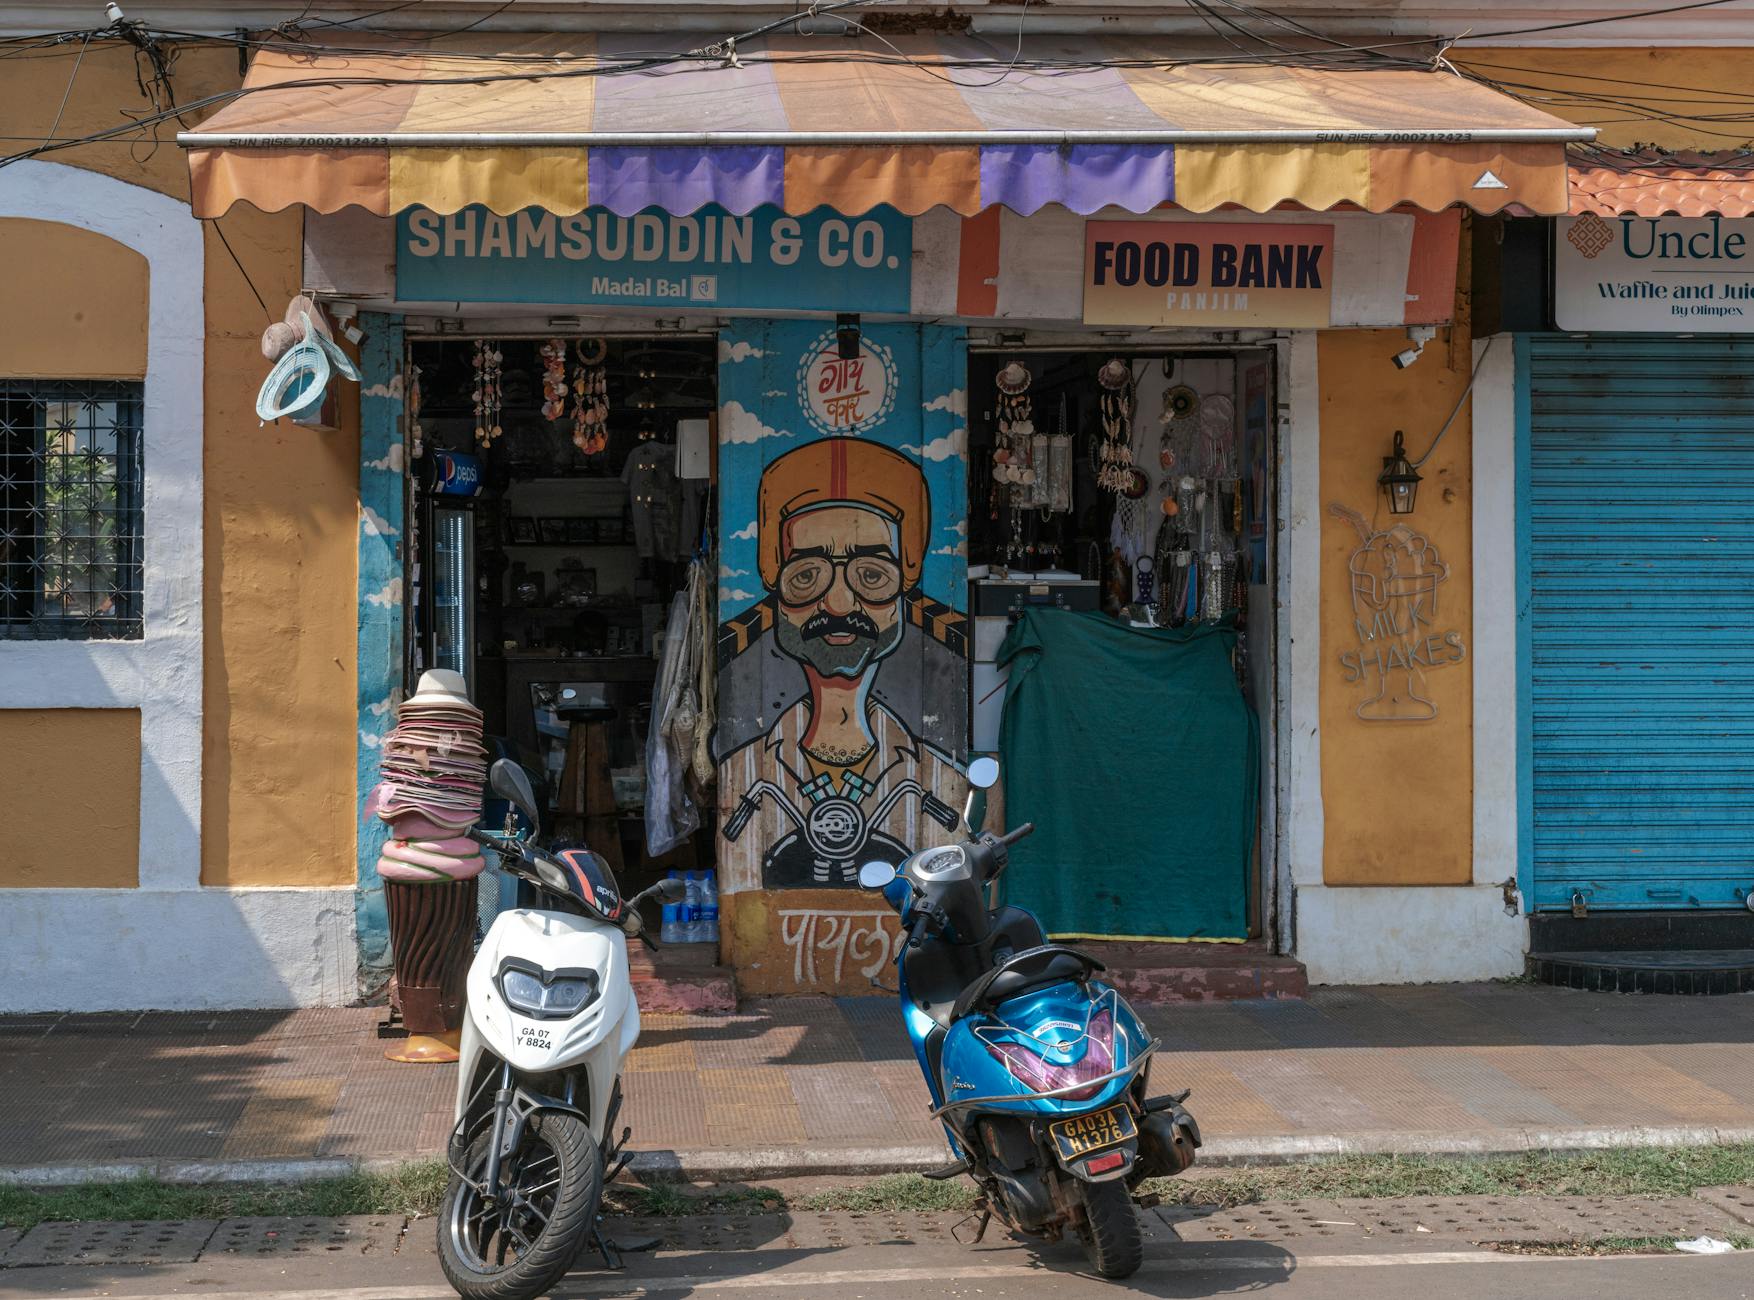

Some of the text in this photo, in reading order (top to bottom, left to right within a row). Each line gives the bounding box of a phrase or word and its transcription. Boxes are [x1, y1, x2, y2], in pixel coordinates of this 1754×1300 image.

[228, 137, 389, 147] SUN RISE 7000212423
[1315, 133, 1472, 142] SUN RISE 7000212423
[408, 209, 899, 269] SHAMSUDDIN & CO.
[1619, 216, 1746, 259] Uncle
[1094, 241, 1324, 289] FOOD BANK
[591, 277, 687, 298] Madal Bal
[1598, 280, 1668, 299] Waffle
[1672, 283, 1713, 299] and
[1167, 292, 1249, 310] PANJIM
[1671, 304, 1744, 317] By Olimpex
[456, 464, 478, 486] pepsi
[1355, 599, 1430, 645] MILK
[1340, 630, 1467, 682] SHAKES
[517, 1036, 551, 1050] Y 8824
[522, 1027, 550, 1039] GA 07
[1069, 1125, 1123, 1153] H1376
